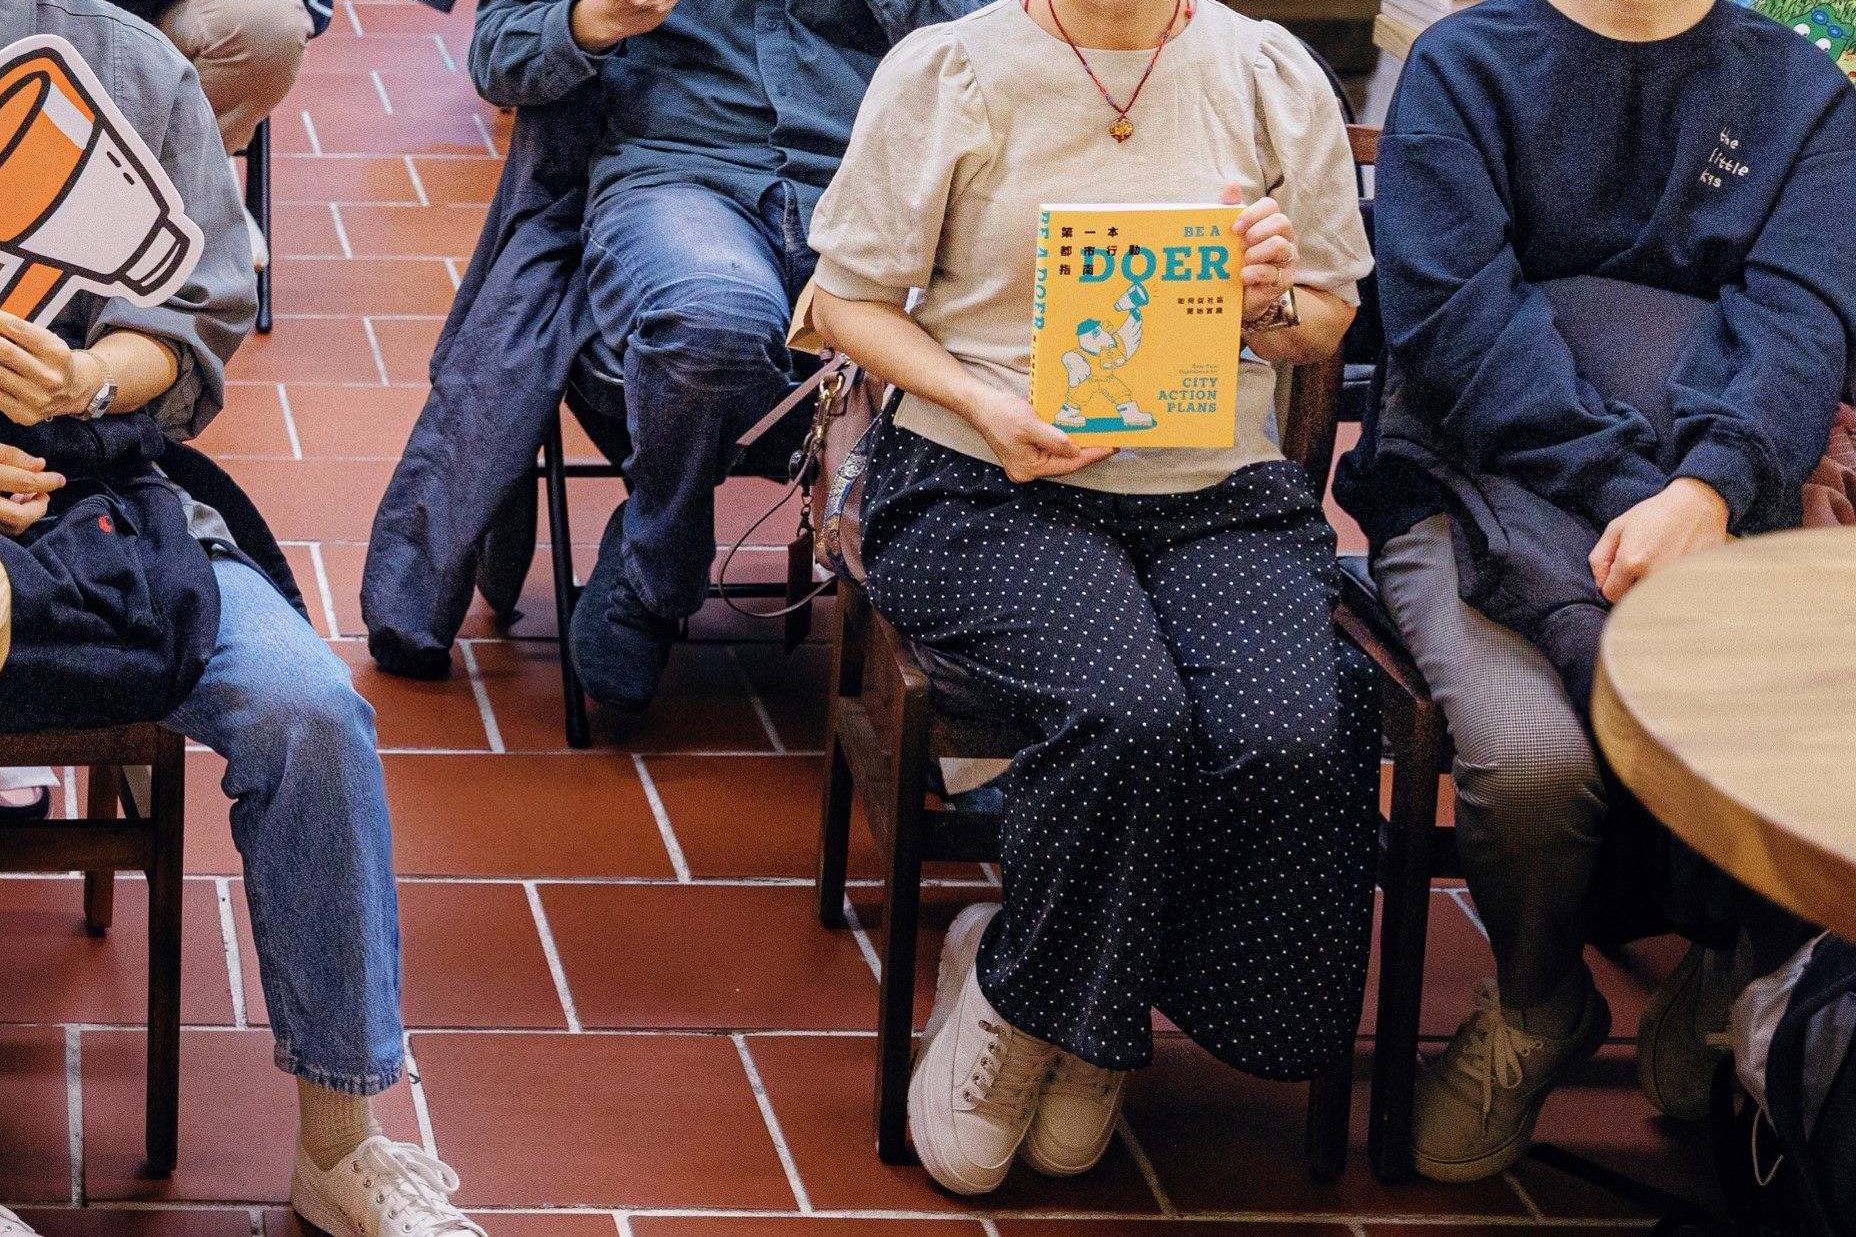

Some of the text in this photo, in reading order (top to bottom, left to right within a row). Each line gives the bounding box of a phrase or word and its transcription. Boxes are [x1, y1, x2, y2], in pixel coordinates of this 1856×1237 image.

[1719, 127, 1739, 149] the
[1708, 147, 1749, 177] little
[1061, 226, 1119, 239] 第一本
[1183, 225, 1221, 238] BE A
[1060, 244, 1141, 257] 都市行動
[1059, 263, 1094, 276] 指南
[1078, 244, 1231, 283] DOER
[1183, 377, 1218, 388] CITY
[1158, 389, 1218, 401] ACTION
[1167, 402, 1217, 413] PLANS
